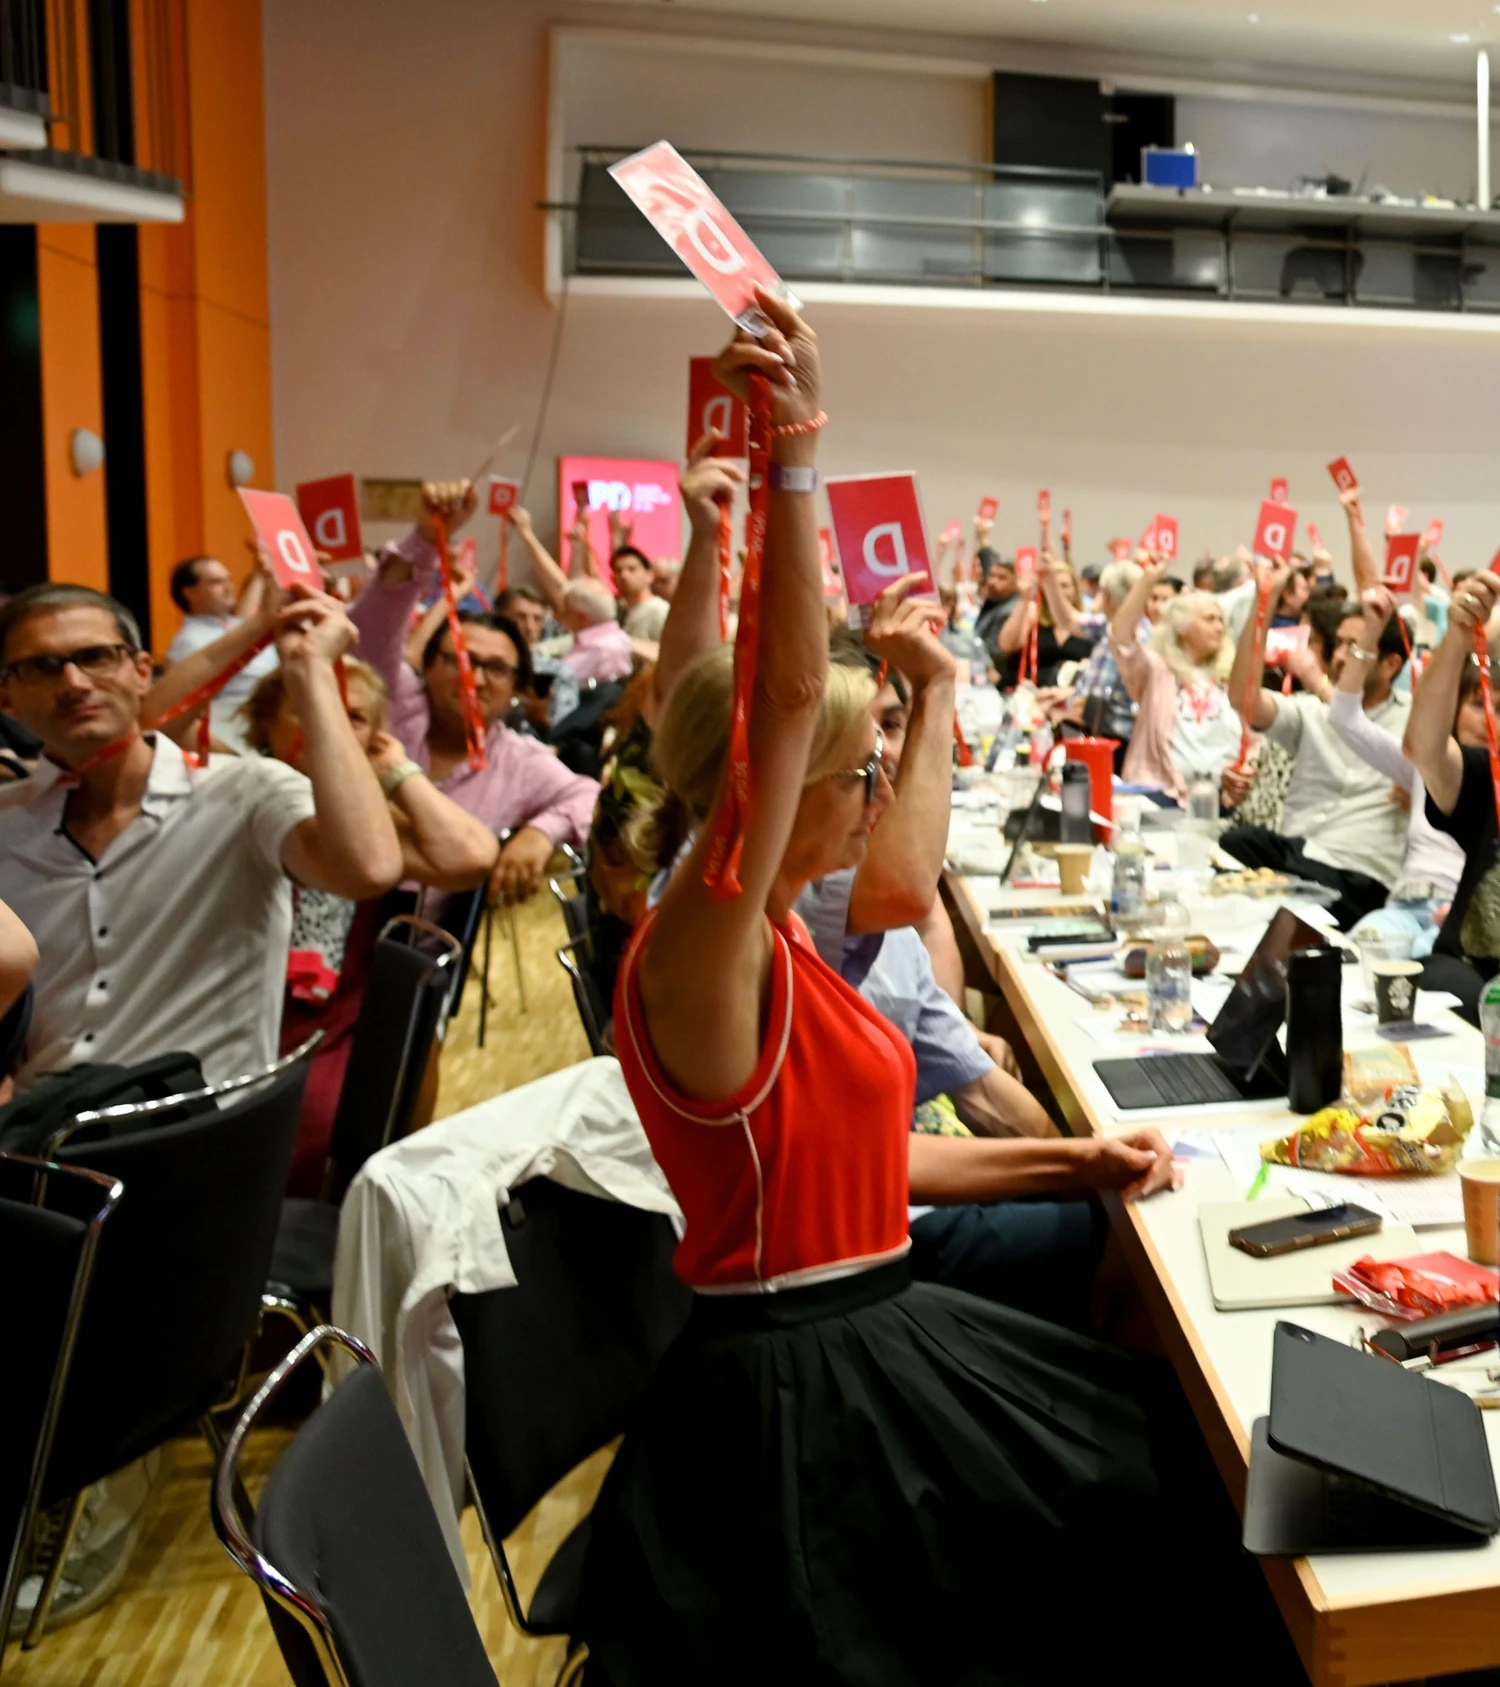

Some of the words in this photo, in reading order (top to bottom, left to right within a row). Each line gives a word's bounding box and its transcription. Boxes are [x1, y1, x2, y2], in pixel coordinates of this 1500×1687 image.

[688, 210, 746, 274] D
[703, 396, 732, 438] D
[572, 480, 632, 512] PD
[316, 508, 347, 547] D
[1265, 523, 1286, 550] D
[277, 530, 311, 573] D
[863, 523, 909, 576] D
[1392, 554, 1410, 583] D
